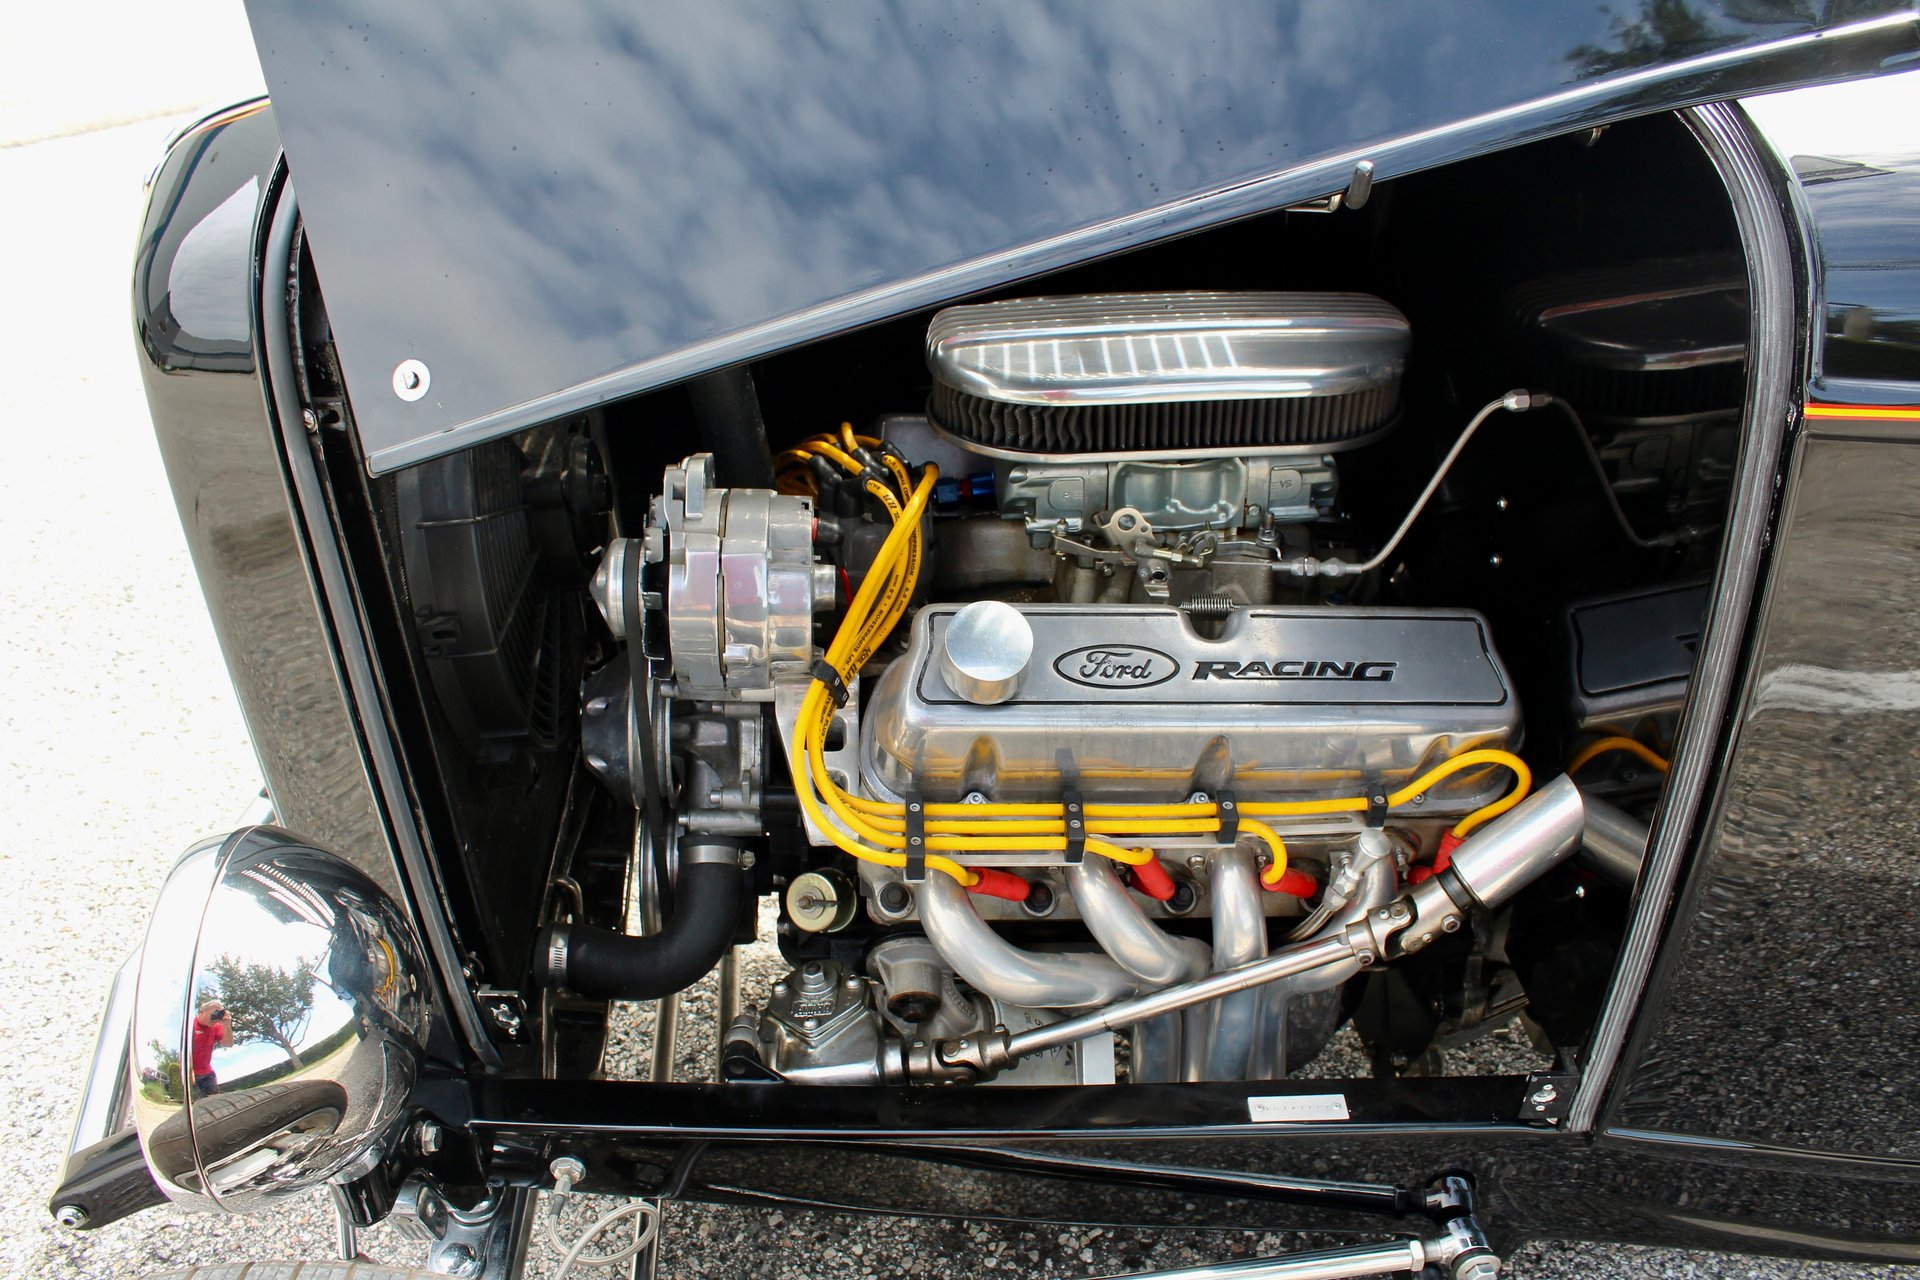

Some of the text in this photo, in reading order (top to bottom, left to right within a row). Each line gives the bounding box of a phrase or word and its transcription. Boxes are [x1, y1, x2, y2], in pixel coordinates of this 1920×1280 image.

[853, 609, 884, 653] SUPPRESSION
[1079, 651, 1398, 682] Ford RACING
